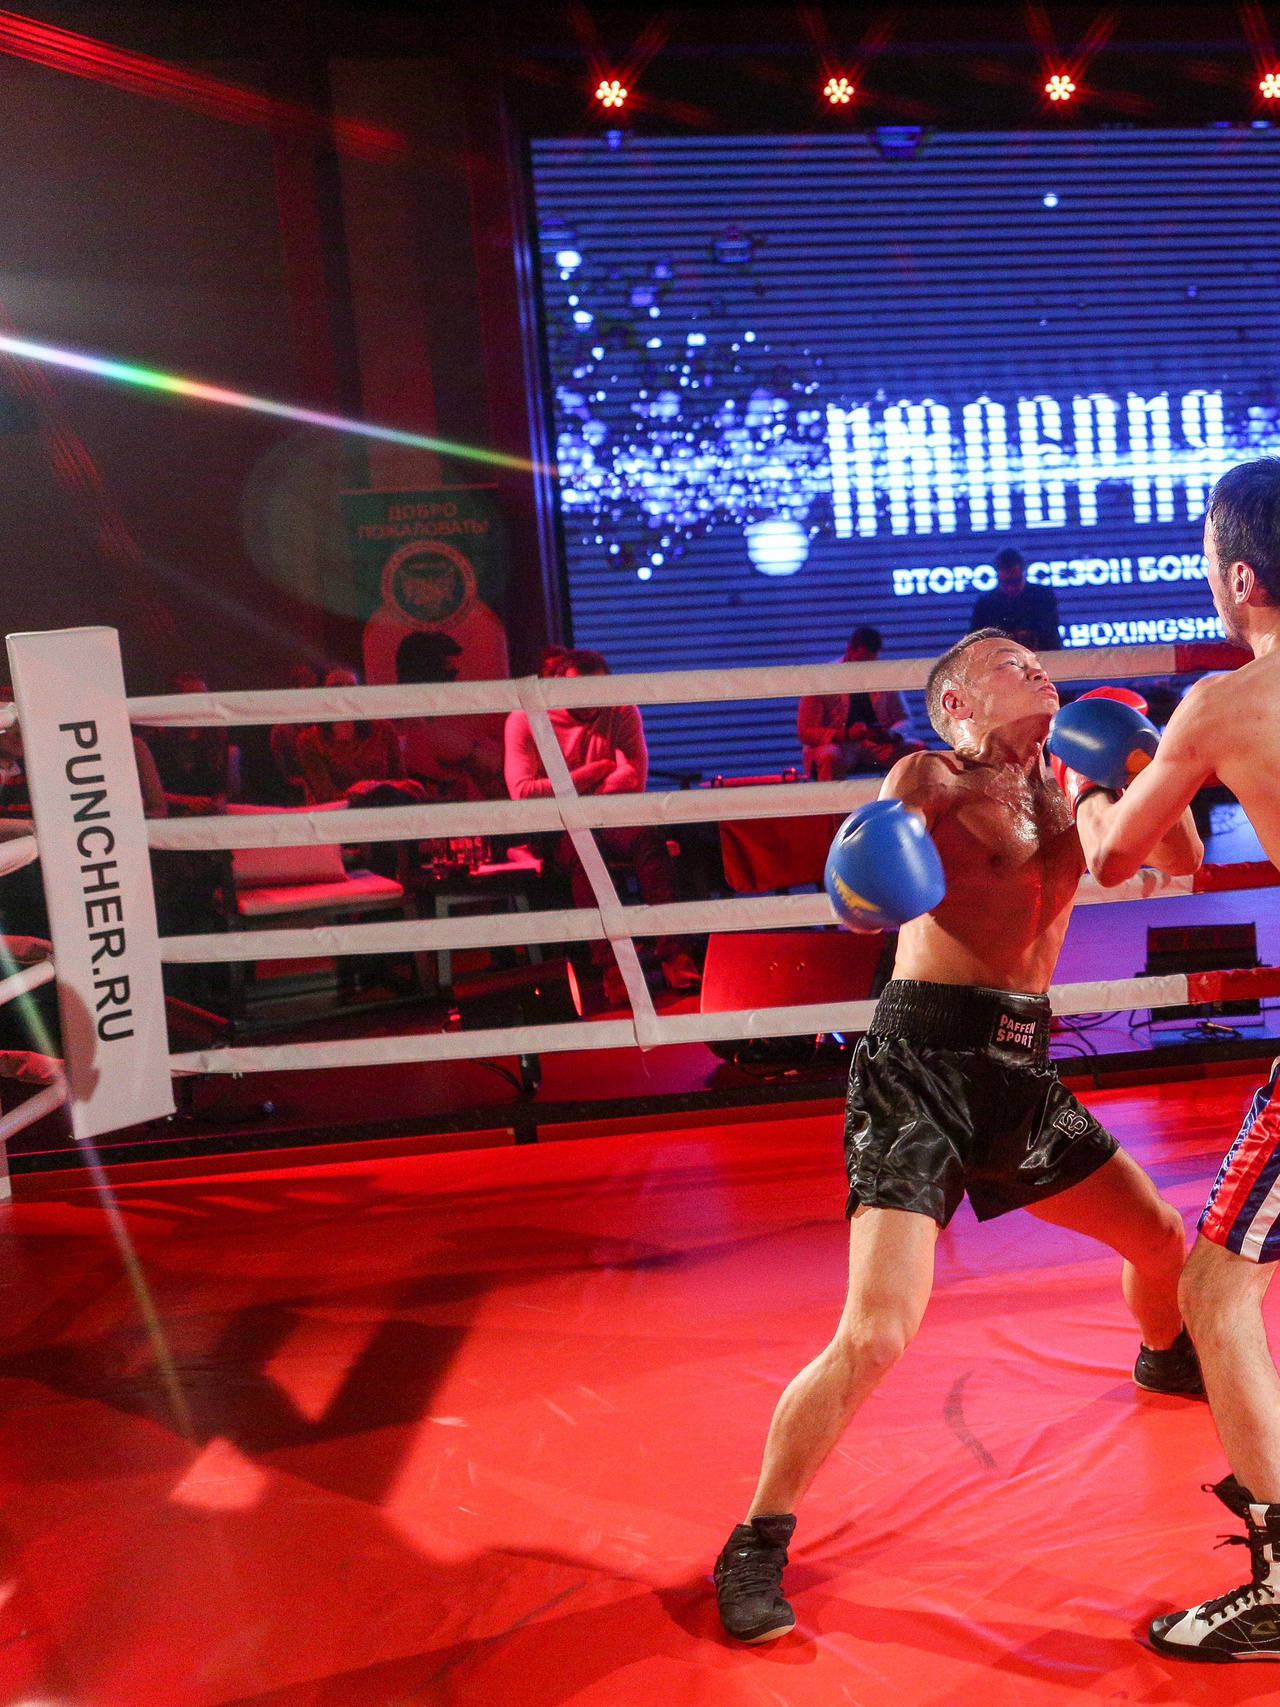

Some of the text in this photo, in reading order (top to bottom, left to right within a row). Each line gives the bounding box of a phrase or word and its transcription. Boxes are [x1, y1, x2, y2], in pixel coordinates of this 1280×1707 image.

[387, 502, 458, 522] ДОБРО
[893, 564, 998, 596] ВТОРО
[1026, 558, 1133, 588] СЕЗОН
[59, 720, 134, 1042] PUNCHER.RU
[1000, 1014, 1036, 1035] PAFFEN
[996, 1028, 1033, 1049] SPORT
